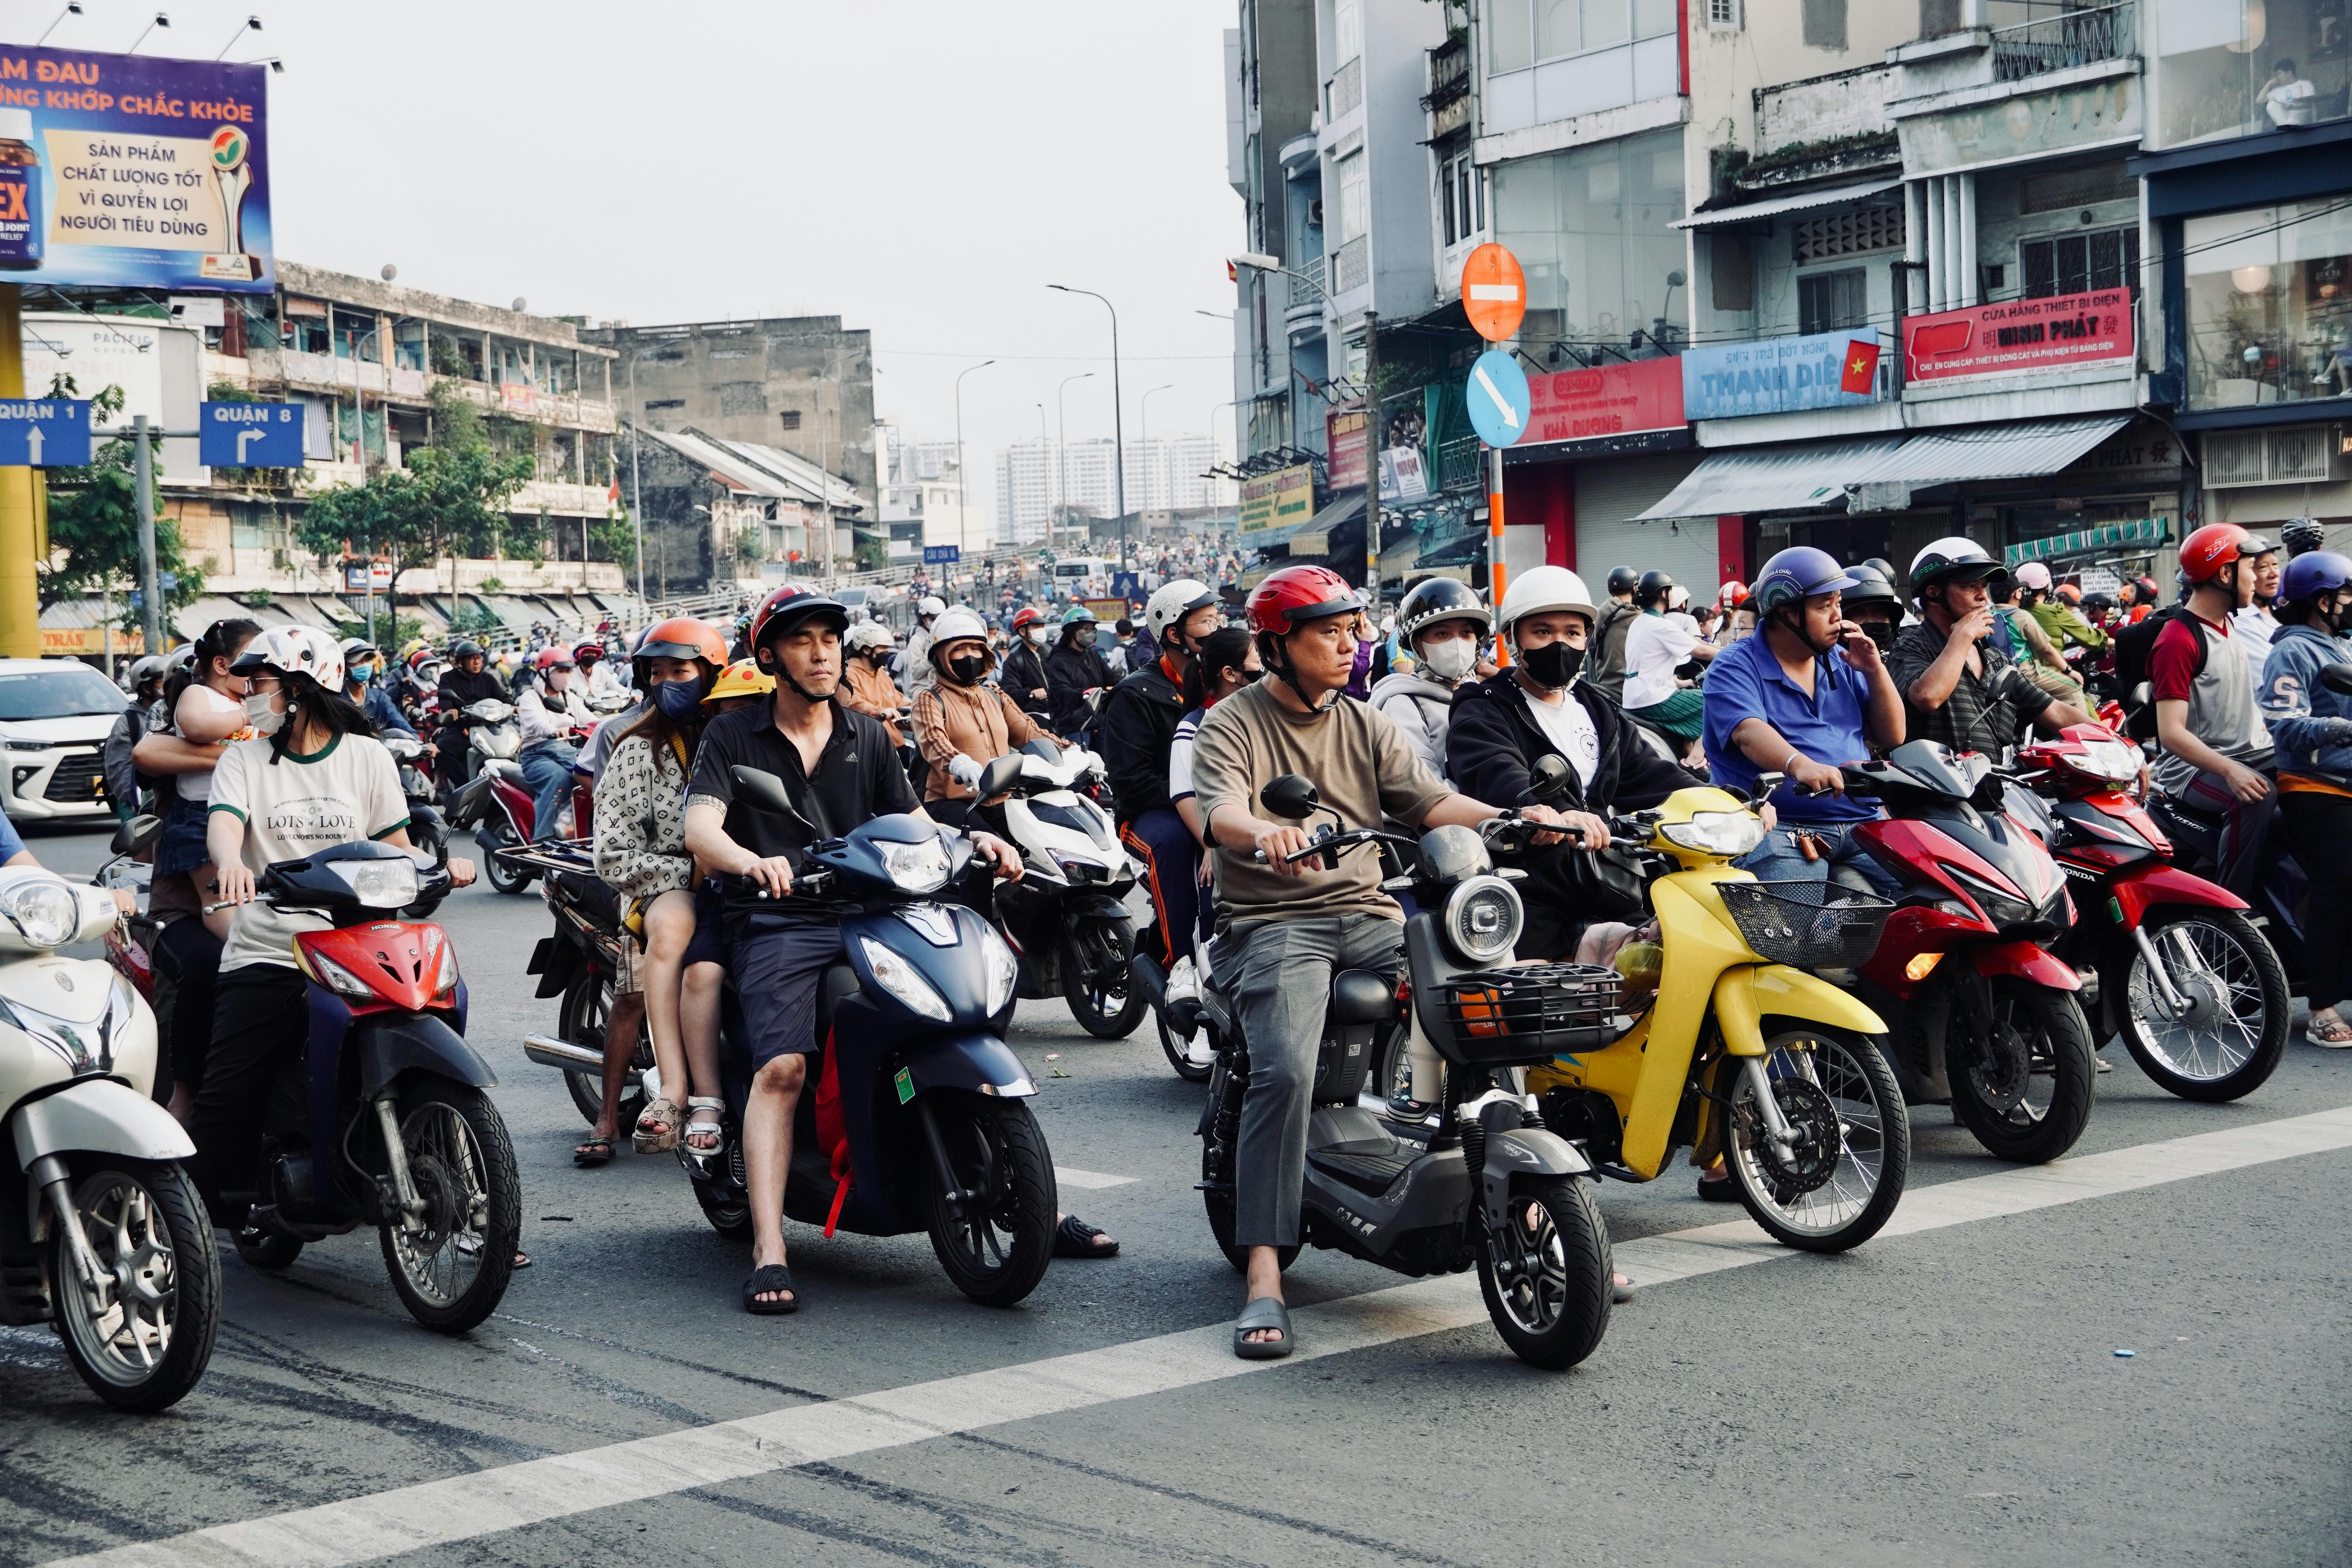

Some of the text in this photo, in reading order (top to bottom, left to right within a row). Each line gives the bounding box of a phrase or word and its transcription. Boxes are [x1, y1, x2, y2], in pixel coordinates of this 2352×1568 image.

[36, 60, 99, 85] ĐAU
[46, 88, 114, 111] KHỚP
[121, 93, 184, 118] CHẮC
[191, 98, 254, 122] KHỎE
[89, 140, 176, 162] SẢN PHẨM
[63, 163, 202, 189] CHẤT LƯỢNG TỐT
[80, 186, 188, 215] VÌ QUYỀN LỢI
[5, 223, 30, 232] JOINT
[61, 213, 208, 236] NGƯỜI TIÊU DÙNG
[29, 243, 38, 253] 60
[1982, 294, 2120, 321] CỬA HÀNG THIẾT BỊ ĐIỆN
[94, 333, 151, 343] PACIFIC
[1983, 329, 1996, 348] 明
[1998, 312, 2099, 347] MINH PHÁT
[94, 347, 151, 356] OUTDOR
[1944, 360, 1960, 368] CUNG
[2031, 349, 2040, 358] VÀ
[2041, 349, 2053, 358] PHỤ
[2054, 347, 2069, 357] KIỆN
[2098, 341, 2114, 352] ĐIỆN
[1557, 375, 1599, 392] OSHIMA
[1701, 365, 1789, 397] THANH
[0, 404, 75, 423] QUẬN 1
[214, 407, 291, 425] QUẬN 8
[1544, 416, 1568, 440] KHẢ
[1919, 561, 1940, 577] PEGA
[2272, 676, 2299, 707] S
[337, 800, 350, 809] PLACE
[267, 815, 303, 829] LOTS
[320, 815, 355, 829] LOVE
